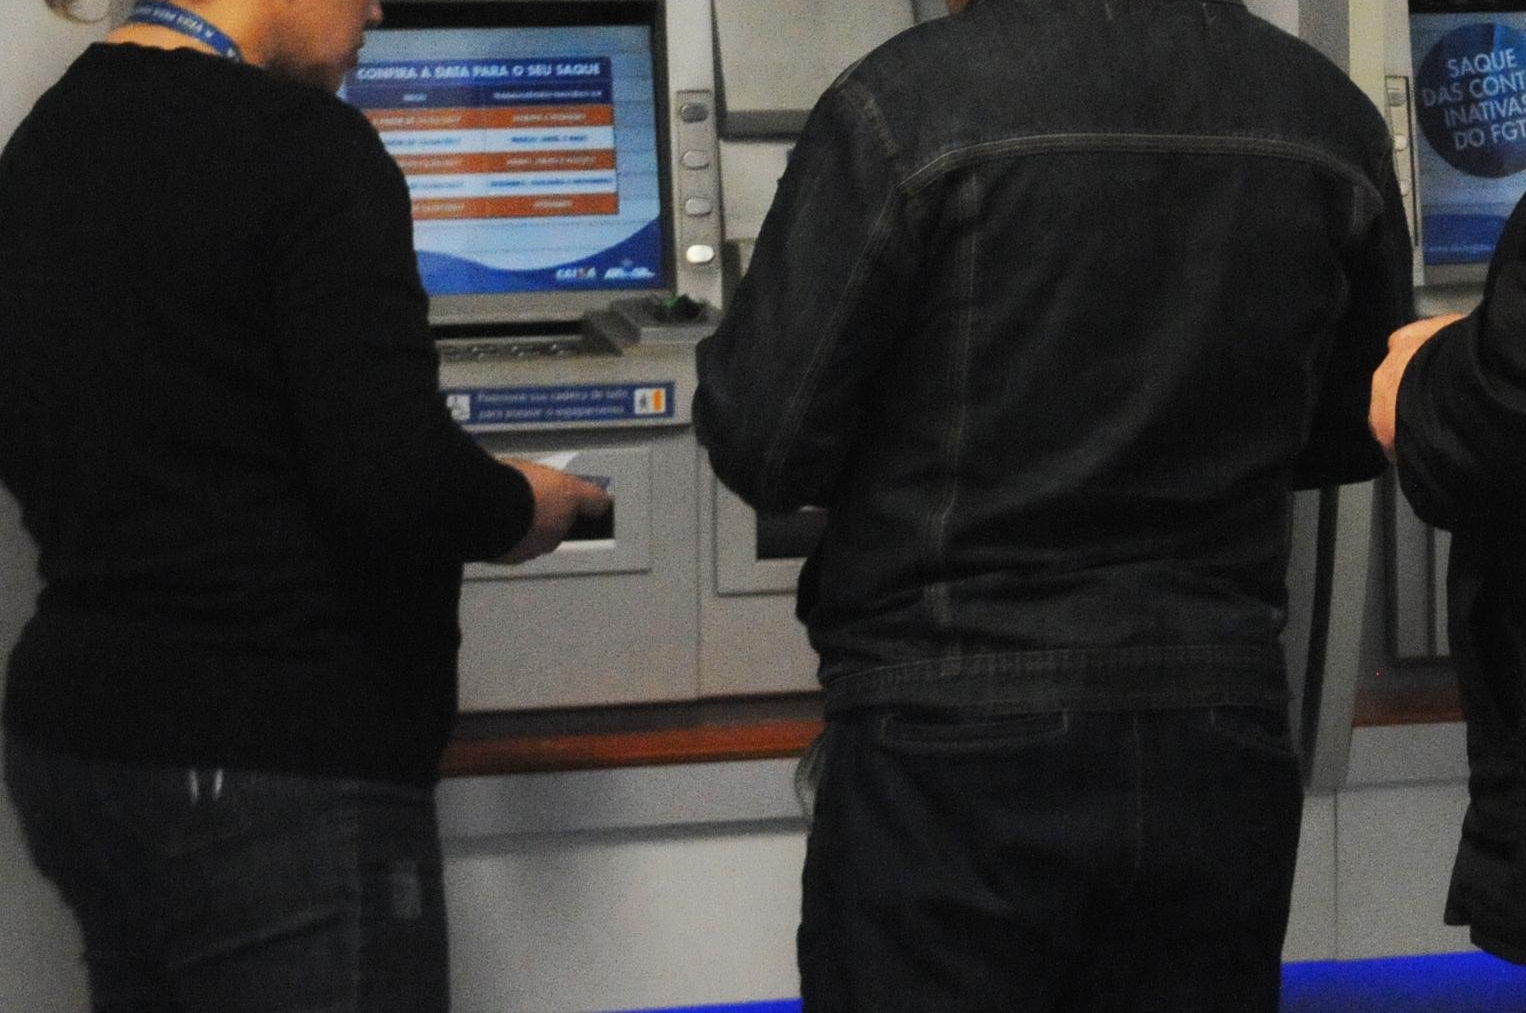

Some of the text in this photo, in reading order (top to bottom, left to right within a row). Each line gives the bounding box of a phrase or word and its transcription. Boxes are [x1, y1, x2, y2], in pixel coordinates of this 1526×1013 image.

[358, 67, 418, 80] CONFIRA
[421, 67, 431, 79] A
[473, 65, 508, 78] PARA
[512, 65, 524, 77] O
[528, 64, 552, 77] SEU
[555, 62, 600, 76] SAQUE
[1448, 48, 1516, 78] SAQUE
[1422, 82, 1463, 107] DAS
[1455, 127, 1484, 150] DO
